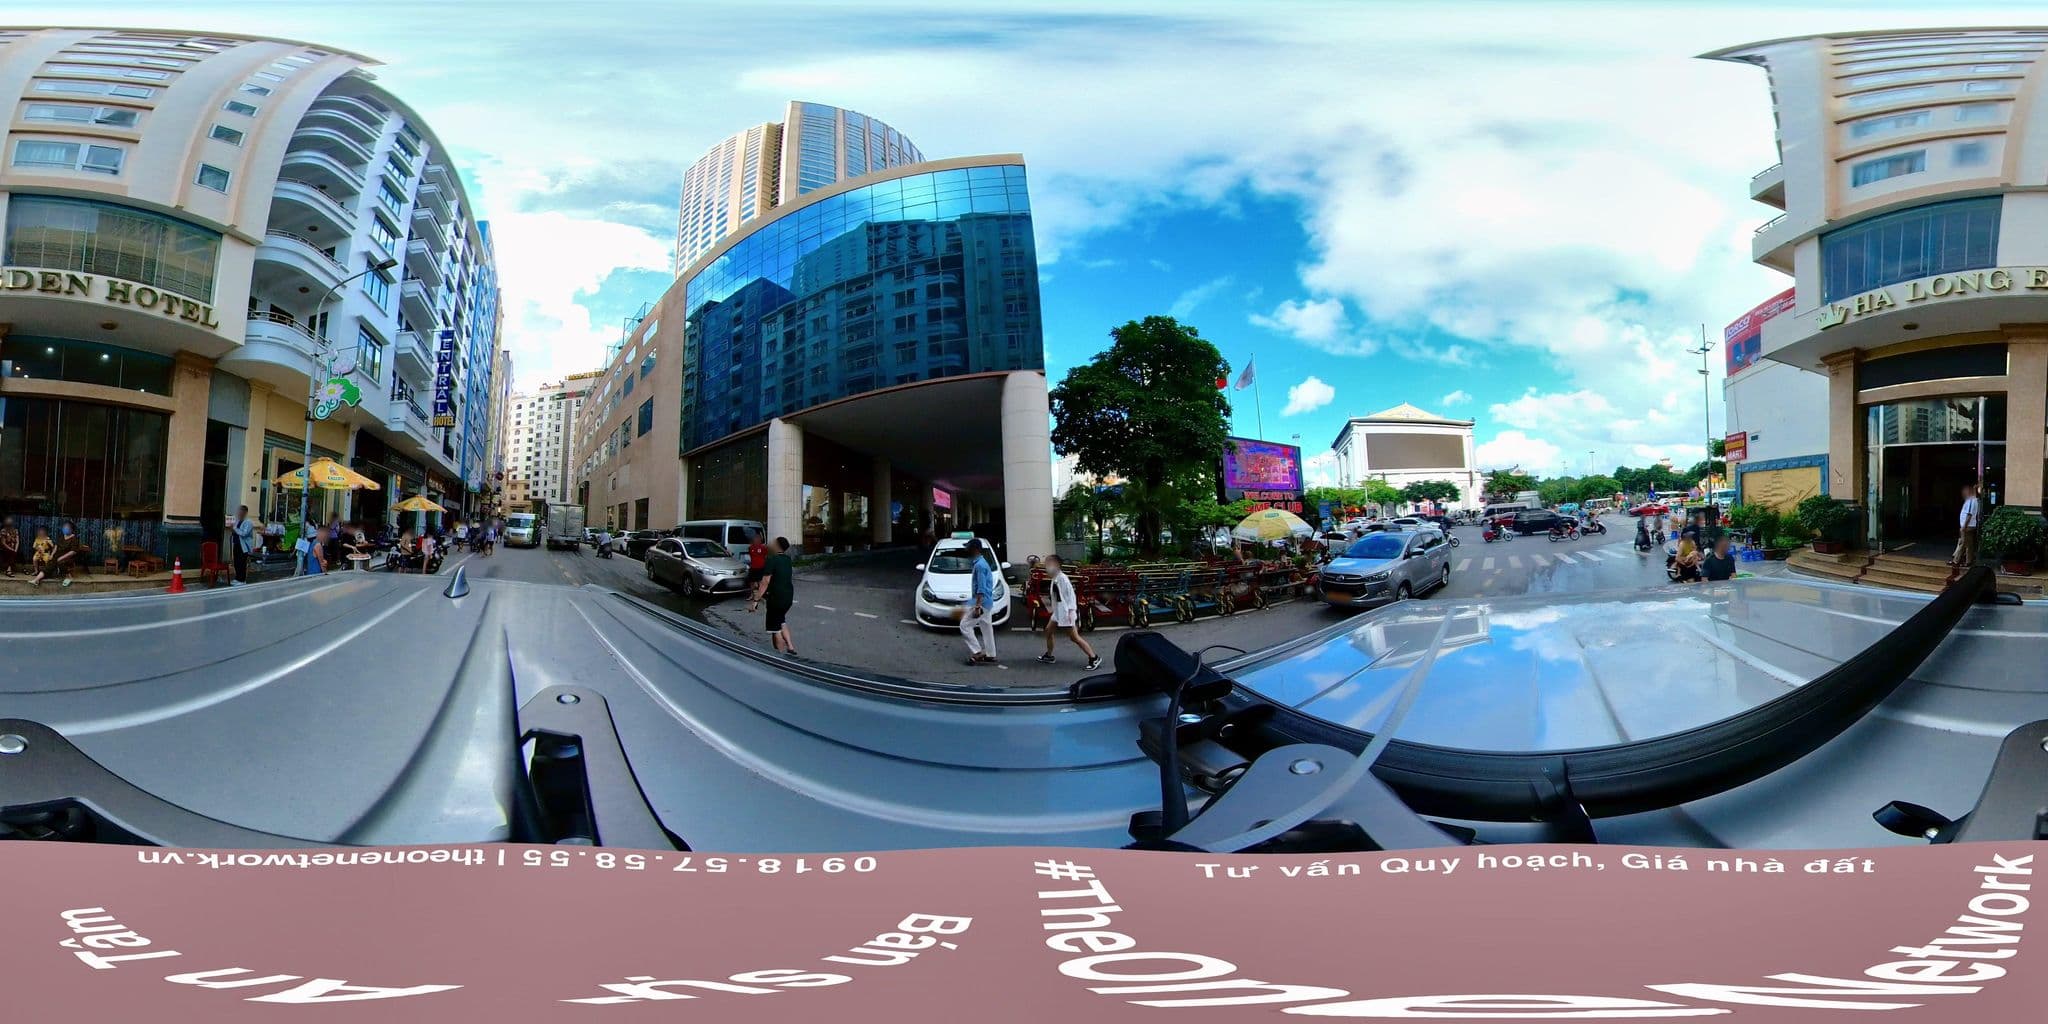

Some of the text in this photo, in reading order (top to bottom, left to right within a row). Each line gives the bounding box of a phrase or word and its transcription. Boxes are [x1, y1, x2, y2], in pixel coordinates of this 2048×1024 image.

[105, 279, 220, 330] HOTEL
[1853, 294, 1896, 317] HA
[1905, 269, 2013, 303] LONG
[433, 416, 453, 426] HOTEL
[1284, 491, 1296, 501] TO
